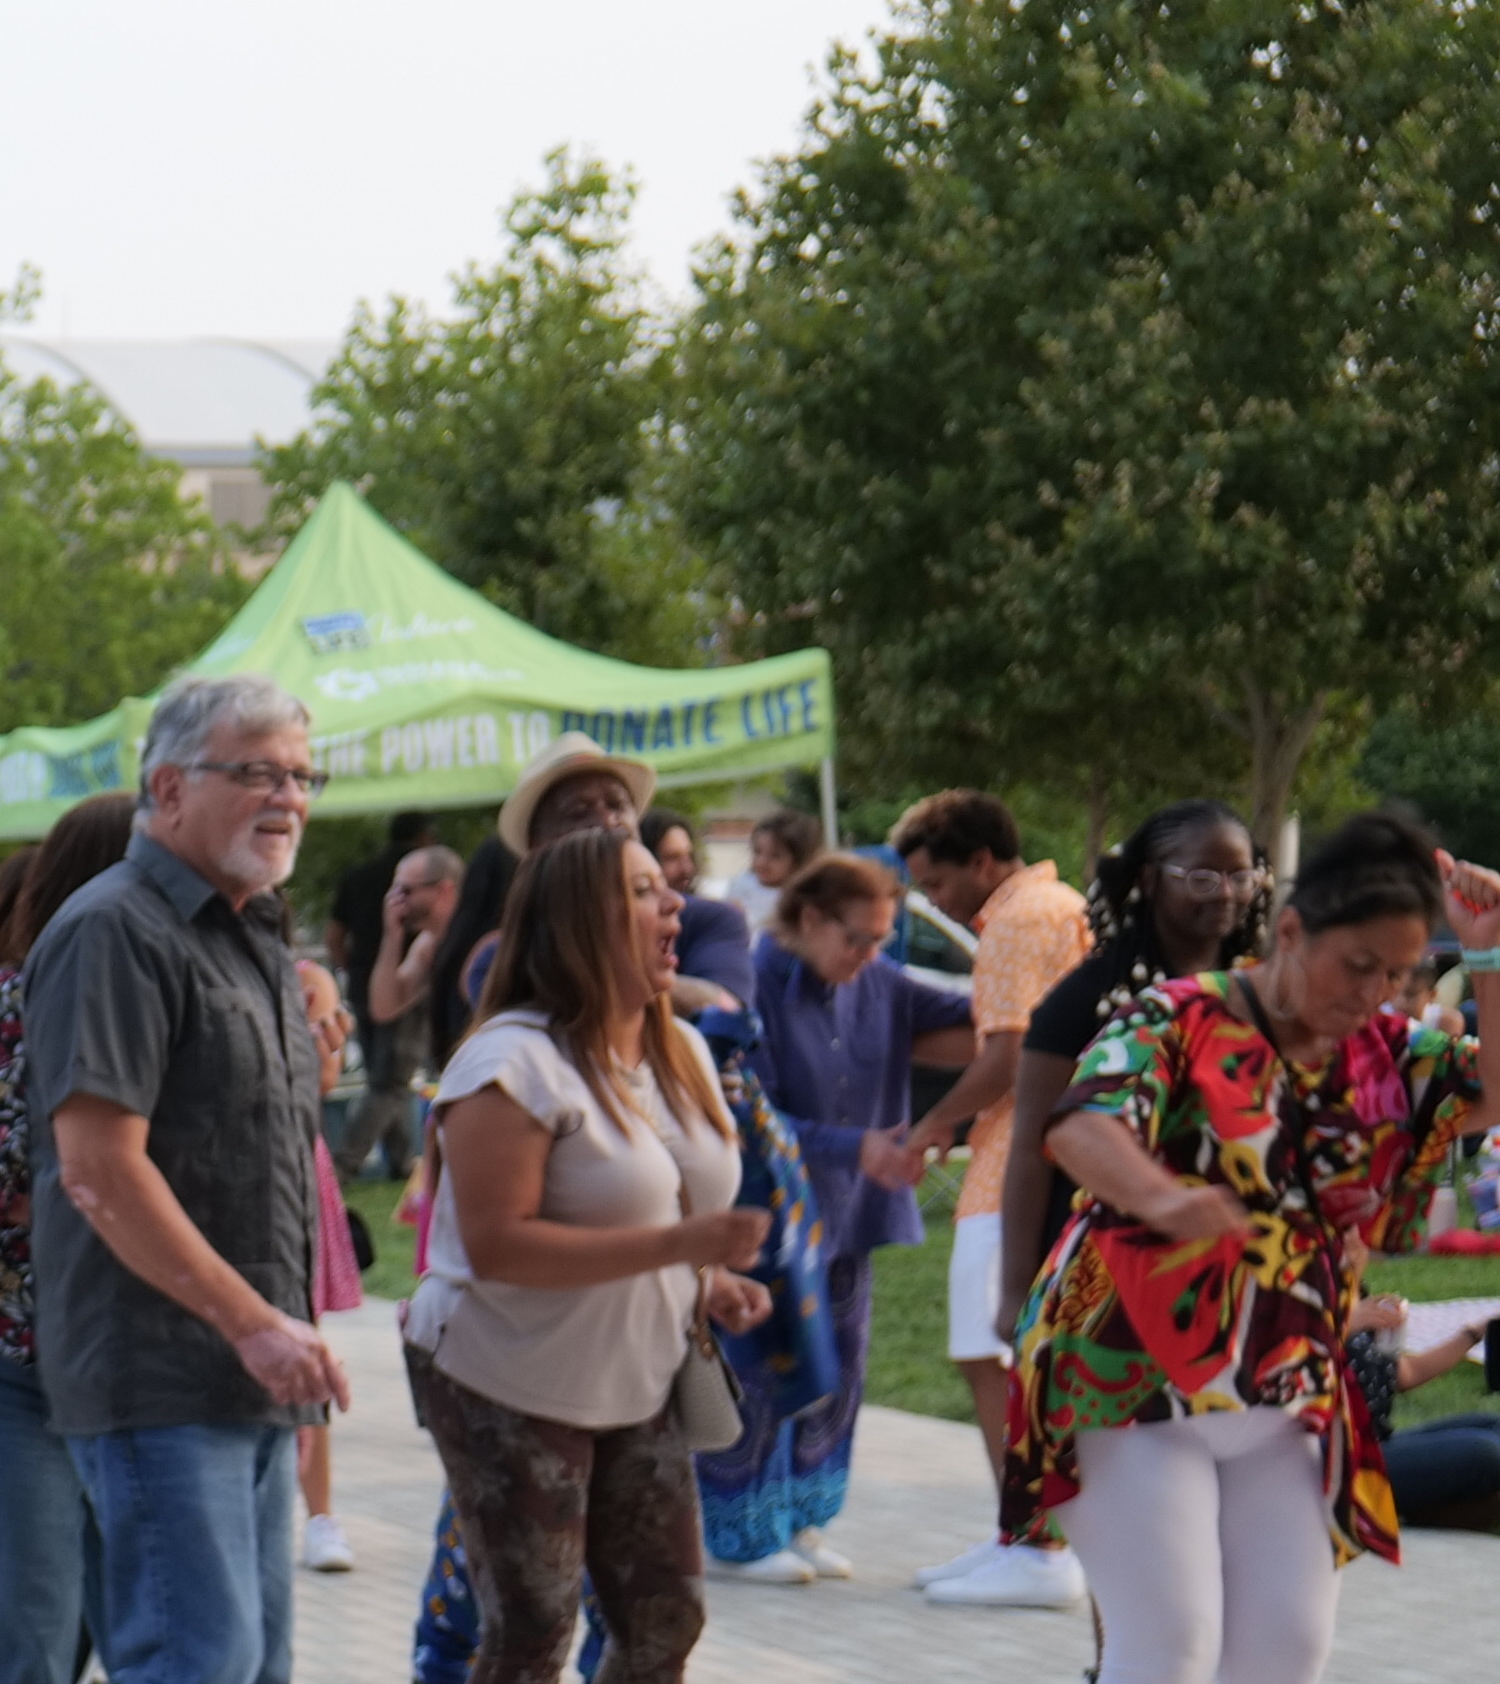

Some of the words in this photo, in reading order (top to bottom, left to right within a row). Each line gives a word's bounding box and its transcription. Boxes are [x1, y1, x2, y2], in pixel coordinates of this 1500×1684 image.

[379, 711, 498, 775] POWER
[507, 710, 551, 763] TO
[741, 679, 818, 738] LIFE
